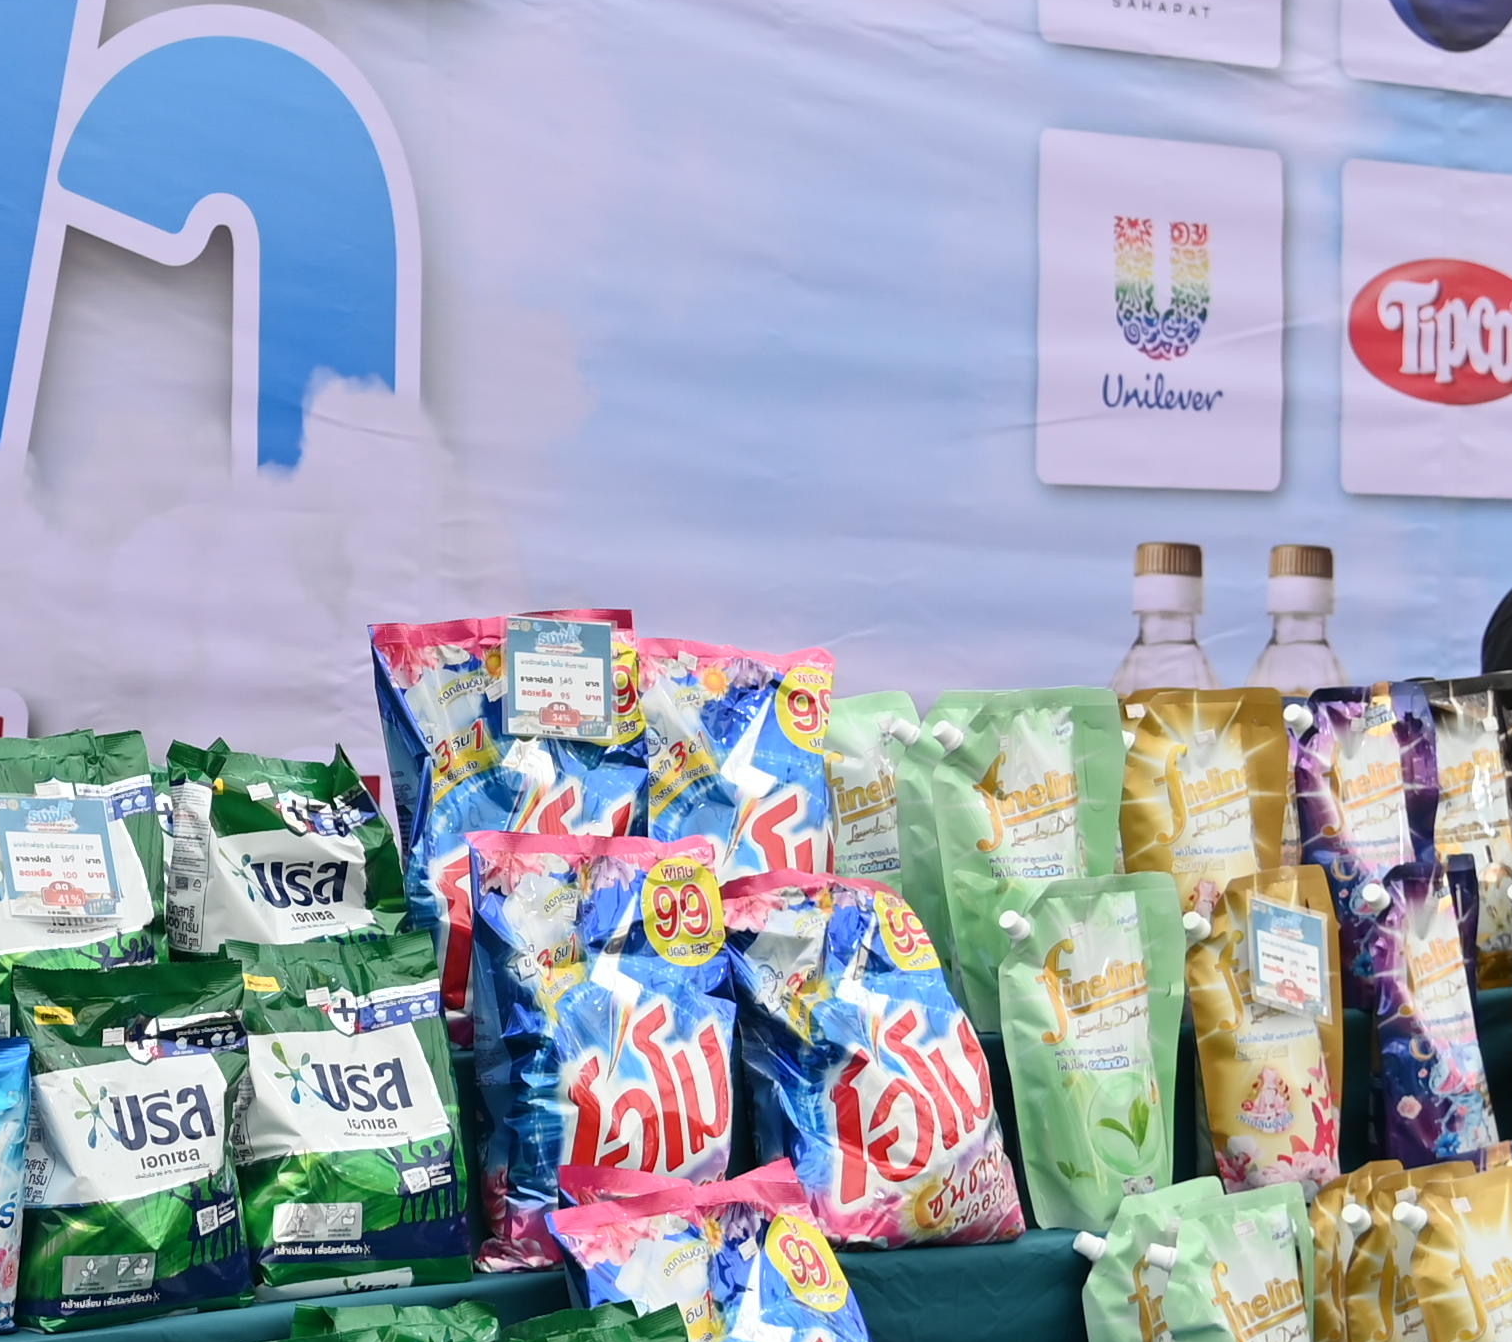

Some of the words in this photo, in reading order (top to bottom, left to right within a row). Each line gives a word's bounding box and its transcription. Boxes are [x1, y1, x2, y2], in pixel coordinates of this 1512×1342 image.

[1102, 371, 1224, 414] Unilever
[560, 692, 571, 700] 95
[85, 857, 102, 865] บาท
[658, 863, 694, 882] พิเศษ
[62, 871, 78, 879] 100
[251, 857, 350, 911] บรีส
[58, 894, 83, 905] 41%
[652, 884, 712, 941] 99
[291, 907, 337, 925] เอกเซล
[312, 1056, 415, 1113] บรีส
[113, 1082, 216, 1151] บรีส
[140, 1145, 201, 1171] เอกเซล
[777, 1234, 828, 1287] 99
